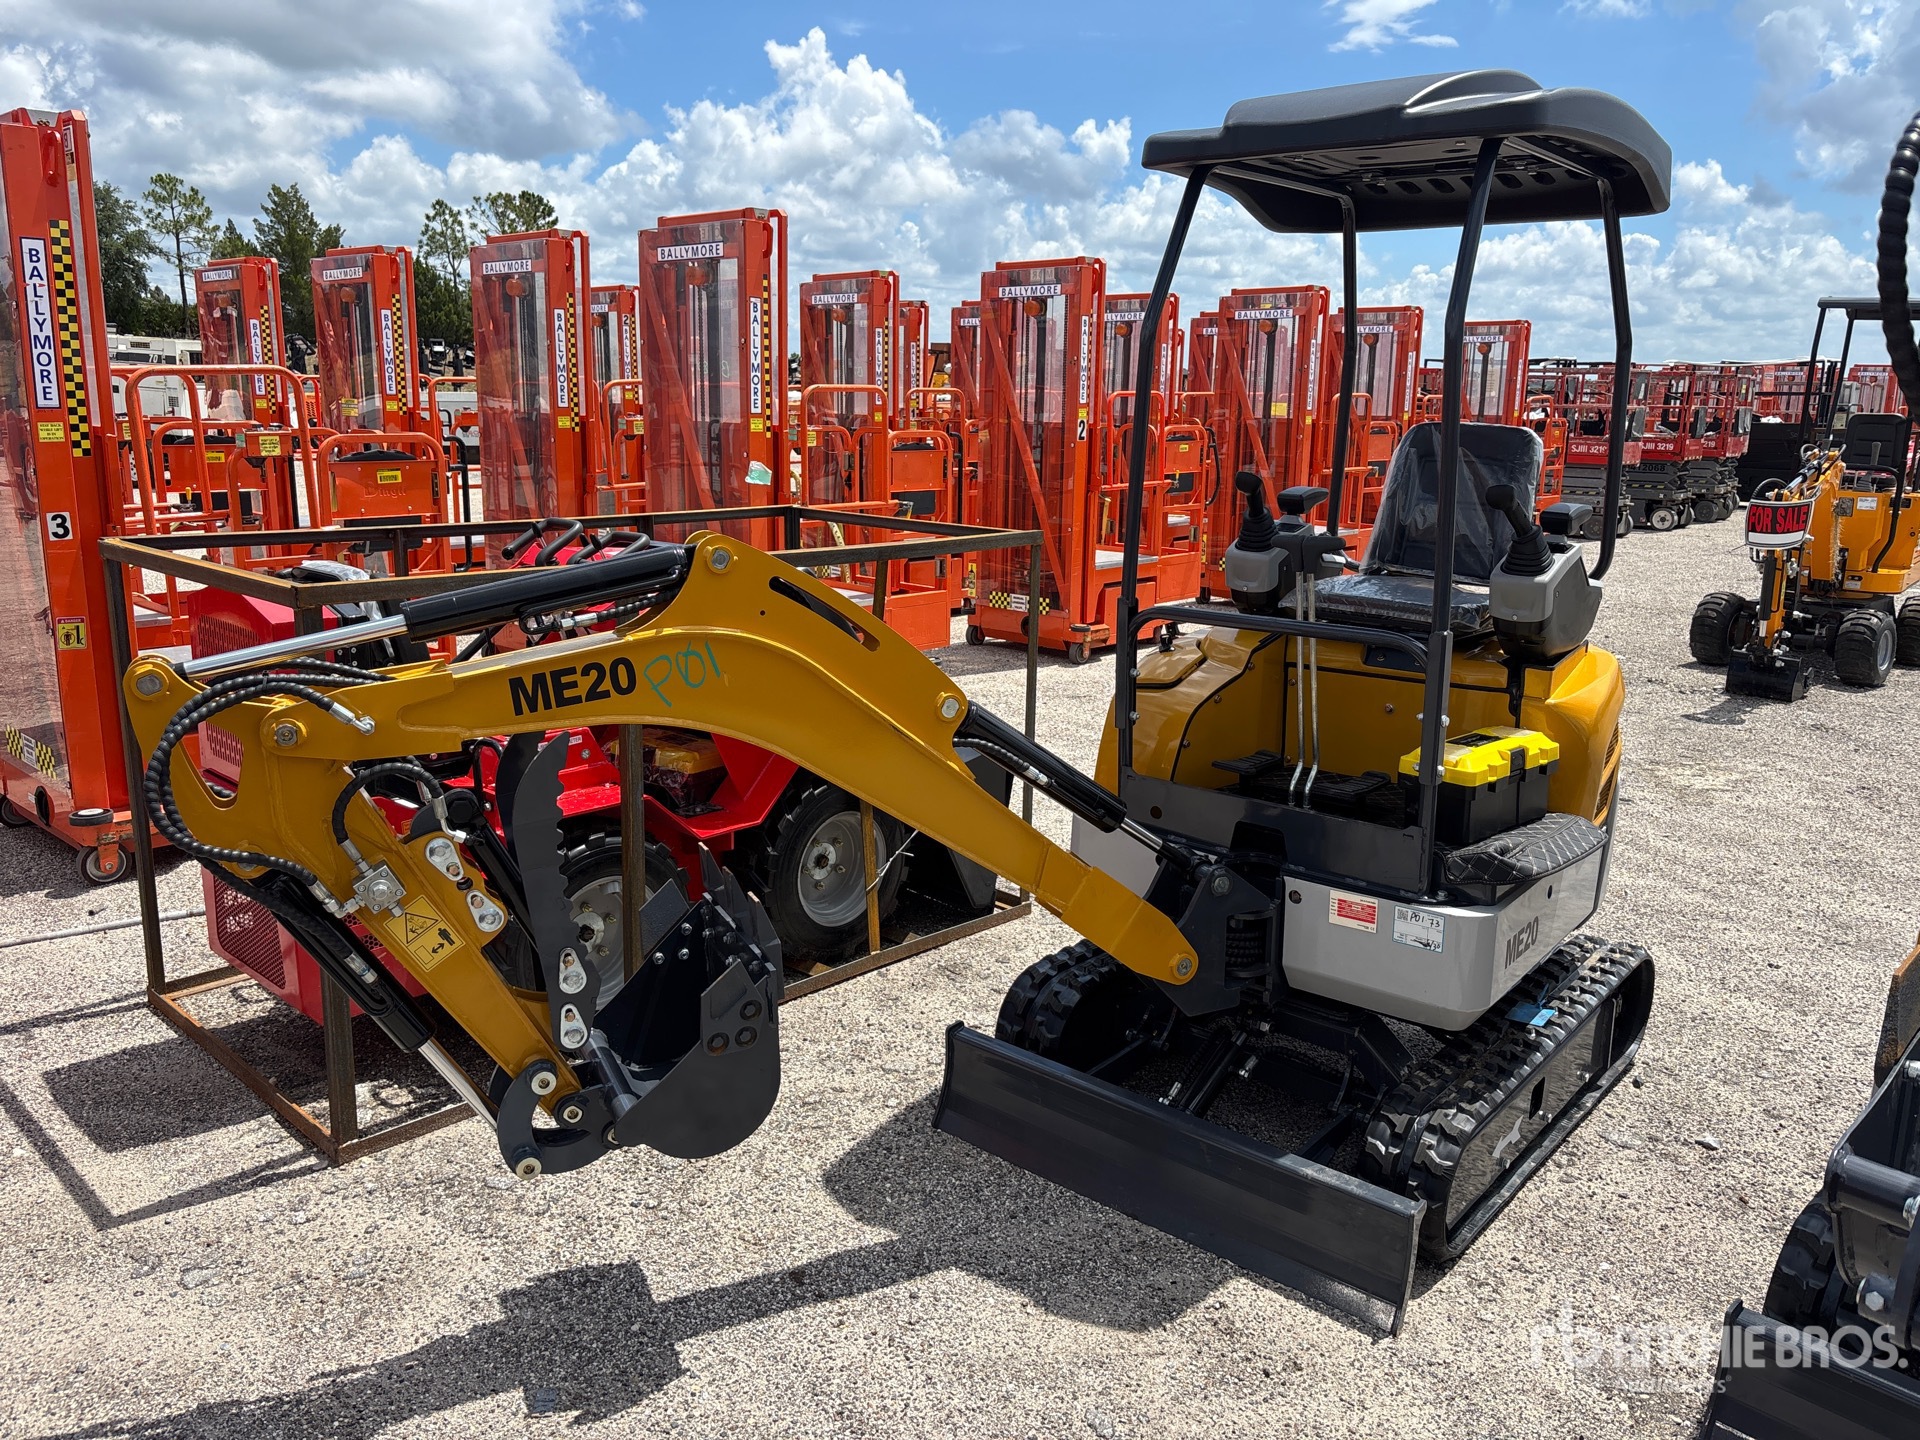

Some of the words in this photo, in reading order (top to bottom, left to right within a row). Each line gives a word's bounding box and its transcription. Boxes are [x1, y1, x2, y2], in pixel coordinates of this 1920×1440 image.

[660, 243, 721, 260] BALLYMORE
[324, 267, 361, 280] BALLYMORE
[484, 260, 530, 273] BALLYMORE
[203, 270, 232, 281] BALLYMORE
[813, 294, 856, 304] BALLYMORE
[1001, 285, 1059, 297] BALLYMORE
[623, 315, 629, 325] 2
[1237, 309, 1290, 319] BALLYMORE
[28, 248, 53, 401] BALLYMORE
[149, 355, 158, 363] 70
[384, 314, 394, 391] BALLYMORE
[557, 313, 567, 404] BALLYMORE
[751, 303, 760, 409] BALLYMORE
[1078, 420, 1086, 441] 2
[1656, 442, 1674, 450] 3219
[51, 513, 70, 539] 3
[1749, 506, 1772, 533] FOR
[1775, 505, 1809, 533] SALE
[508, 656, 637, 717] ME20
[1504, 915, 1539, 970] ME20
